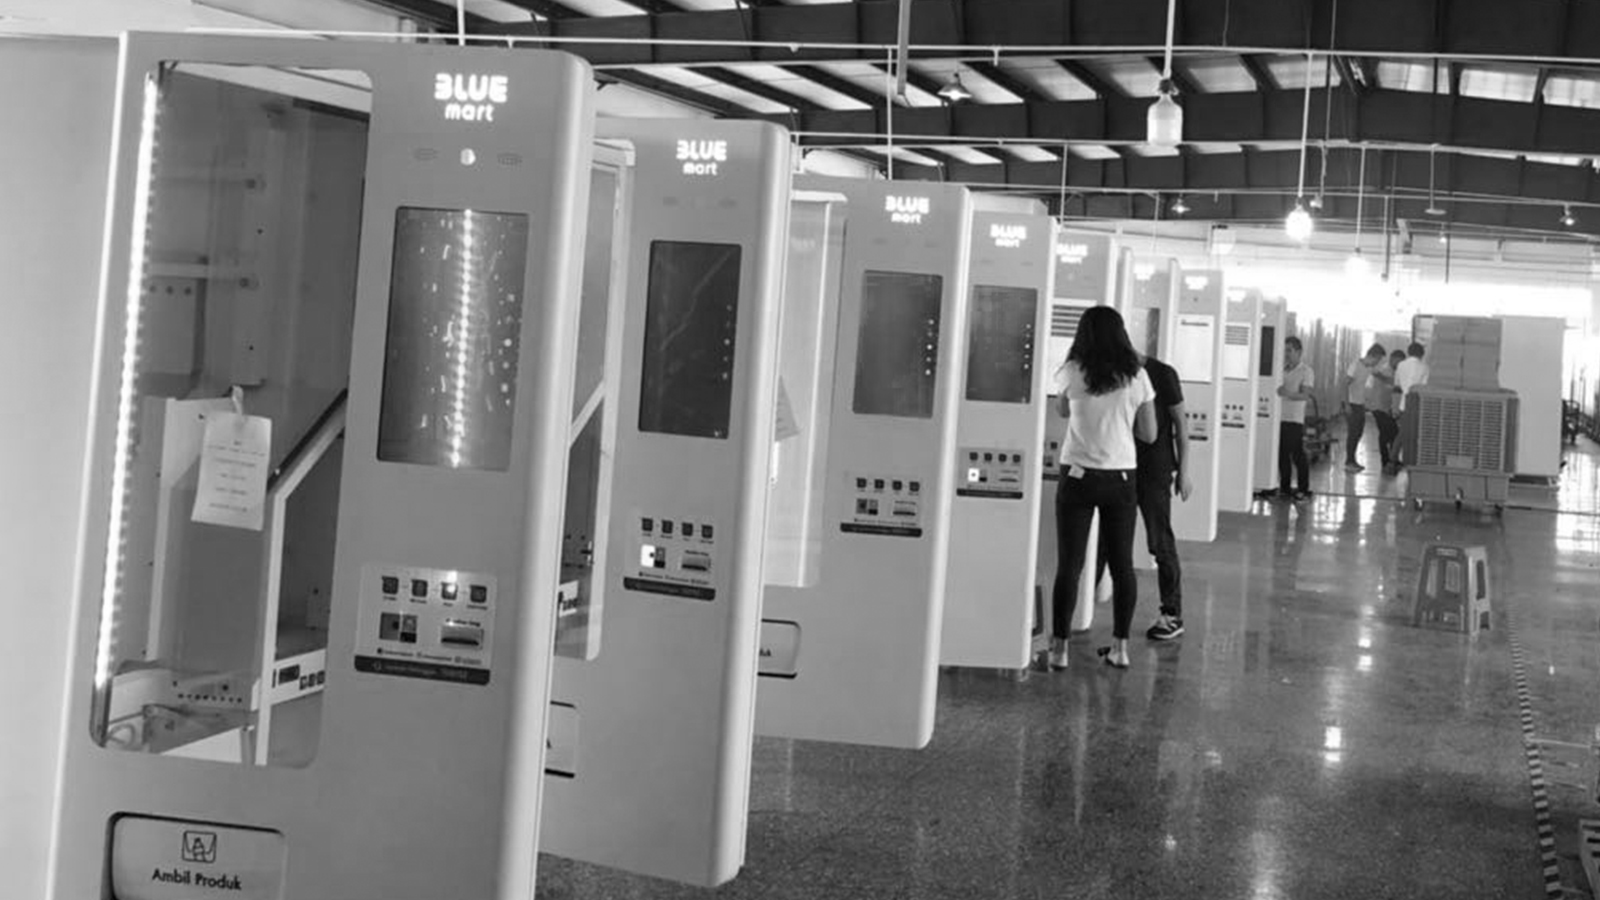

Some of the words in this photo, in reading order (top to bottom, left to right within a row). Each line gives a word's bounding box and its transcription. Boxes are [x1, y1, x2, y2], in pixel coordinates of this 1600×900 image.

[434, 72, 508, 103] BLUE
[445, 102, 494, 122] mart
[676, 139, 727, 161] BLUE
[683, 162, 718, 176] mart
[885, 195, 930, 214] BLUE
[152, 867, 191, 884] Ambil
[195, 872, 242, 891] Produk
